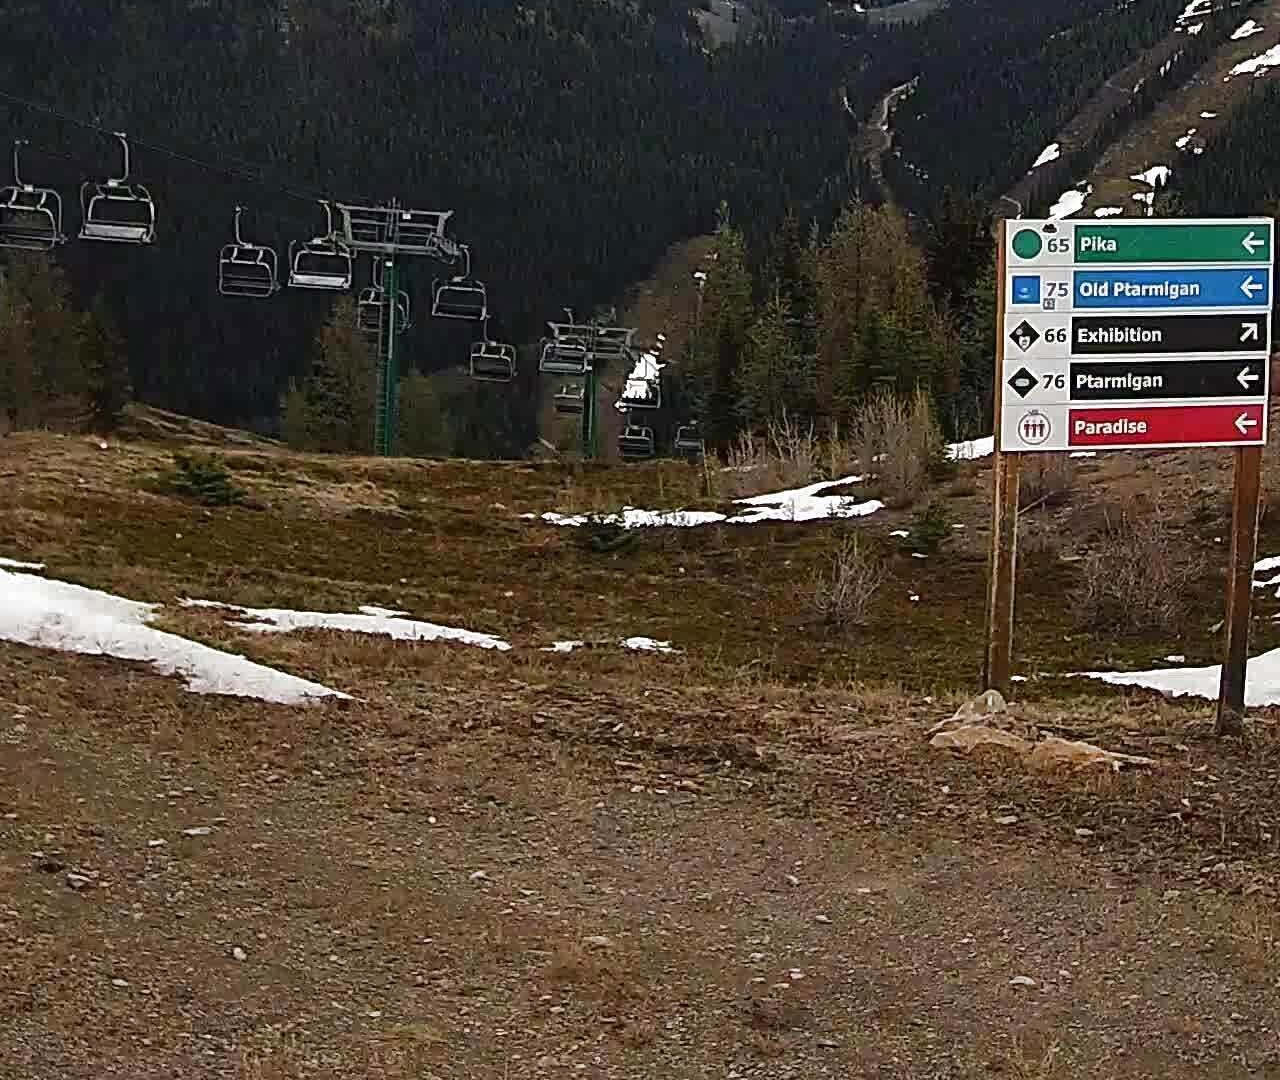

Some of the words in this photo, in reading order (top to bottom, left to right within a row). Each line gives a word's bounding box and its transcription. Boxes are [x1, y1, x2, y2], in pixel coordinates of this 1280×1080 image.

[1047, 238, 1070, 253] 65
[1080, 236, 1117, 252] Pika
[1046, 282, 1069, 297] 75
[1079, 282, 1109, 297] Old
[1113, 281, 1200, 299] Ptarmigan
[1044, 329, 1067, 344] 66
[1077, 327, 1162, 344] Exhibition
[1042, 374, 1065, 389] 76
[1076, 373, 1163, 390] Ptarmigan
[1074, 418, 1147, 435] Paradise
